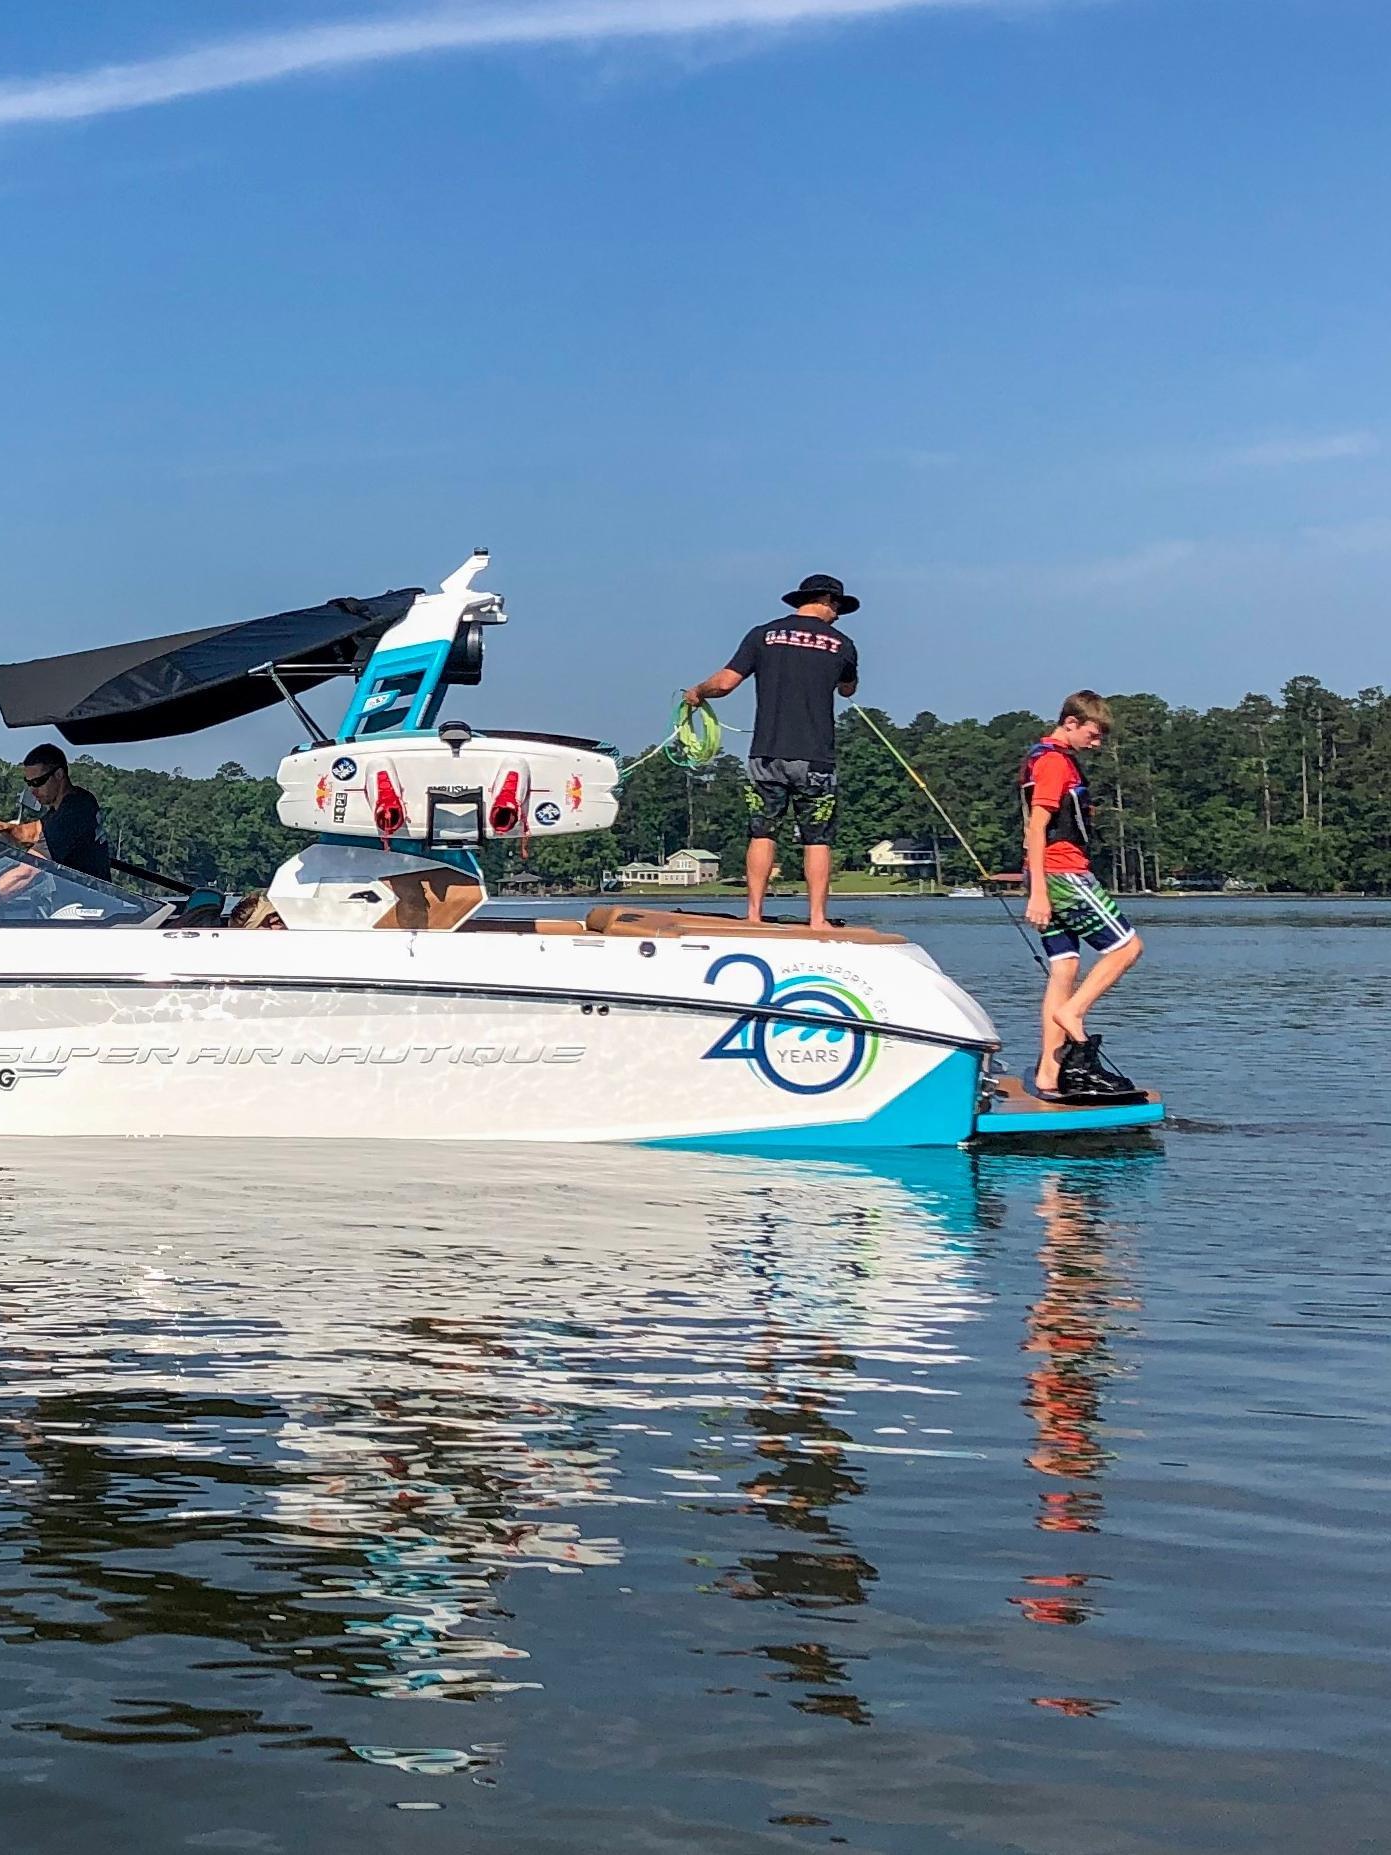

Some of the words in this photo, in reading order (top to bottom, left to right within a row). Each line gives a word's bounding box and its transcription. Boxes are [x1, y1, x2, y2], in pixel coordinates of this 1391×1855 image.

[334, 793, 347, 823] HOPE
[186, 1046, 284, 1064] AIR
[291, 1045, 587, 1066] NAUTIQUE
[777, 1049, 839, 1063] YEARS
